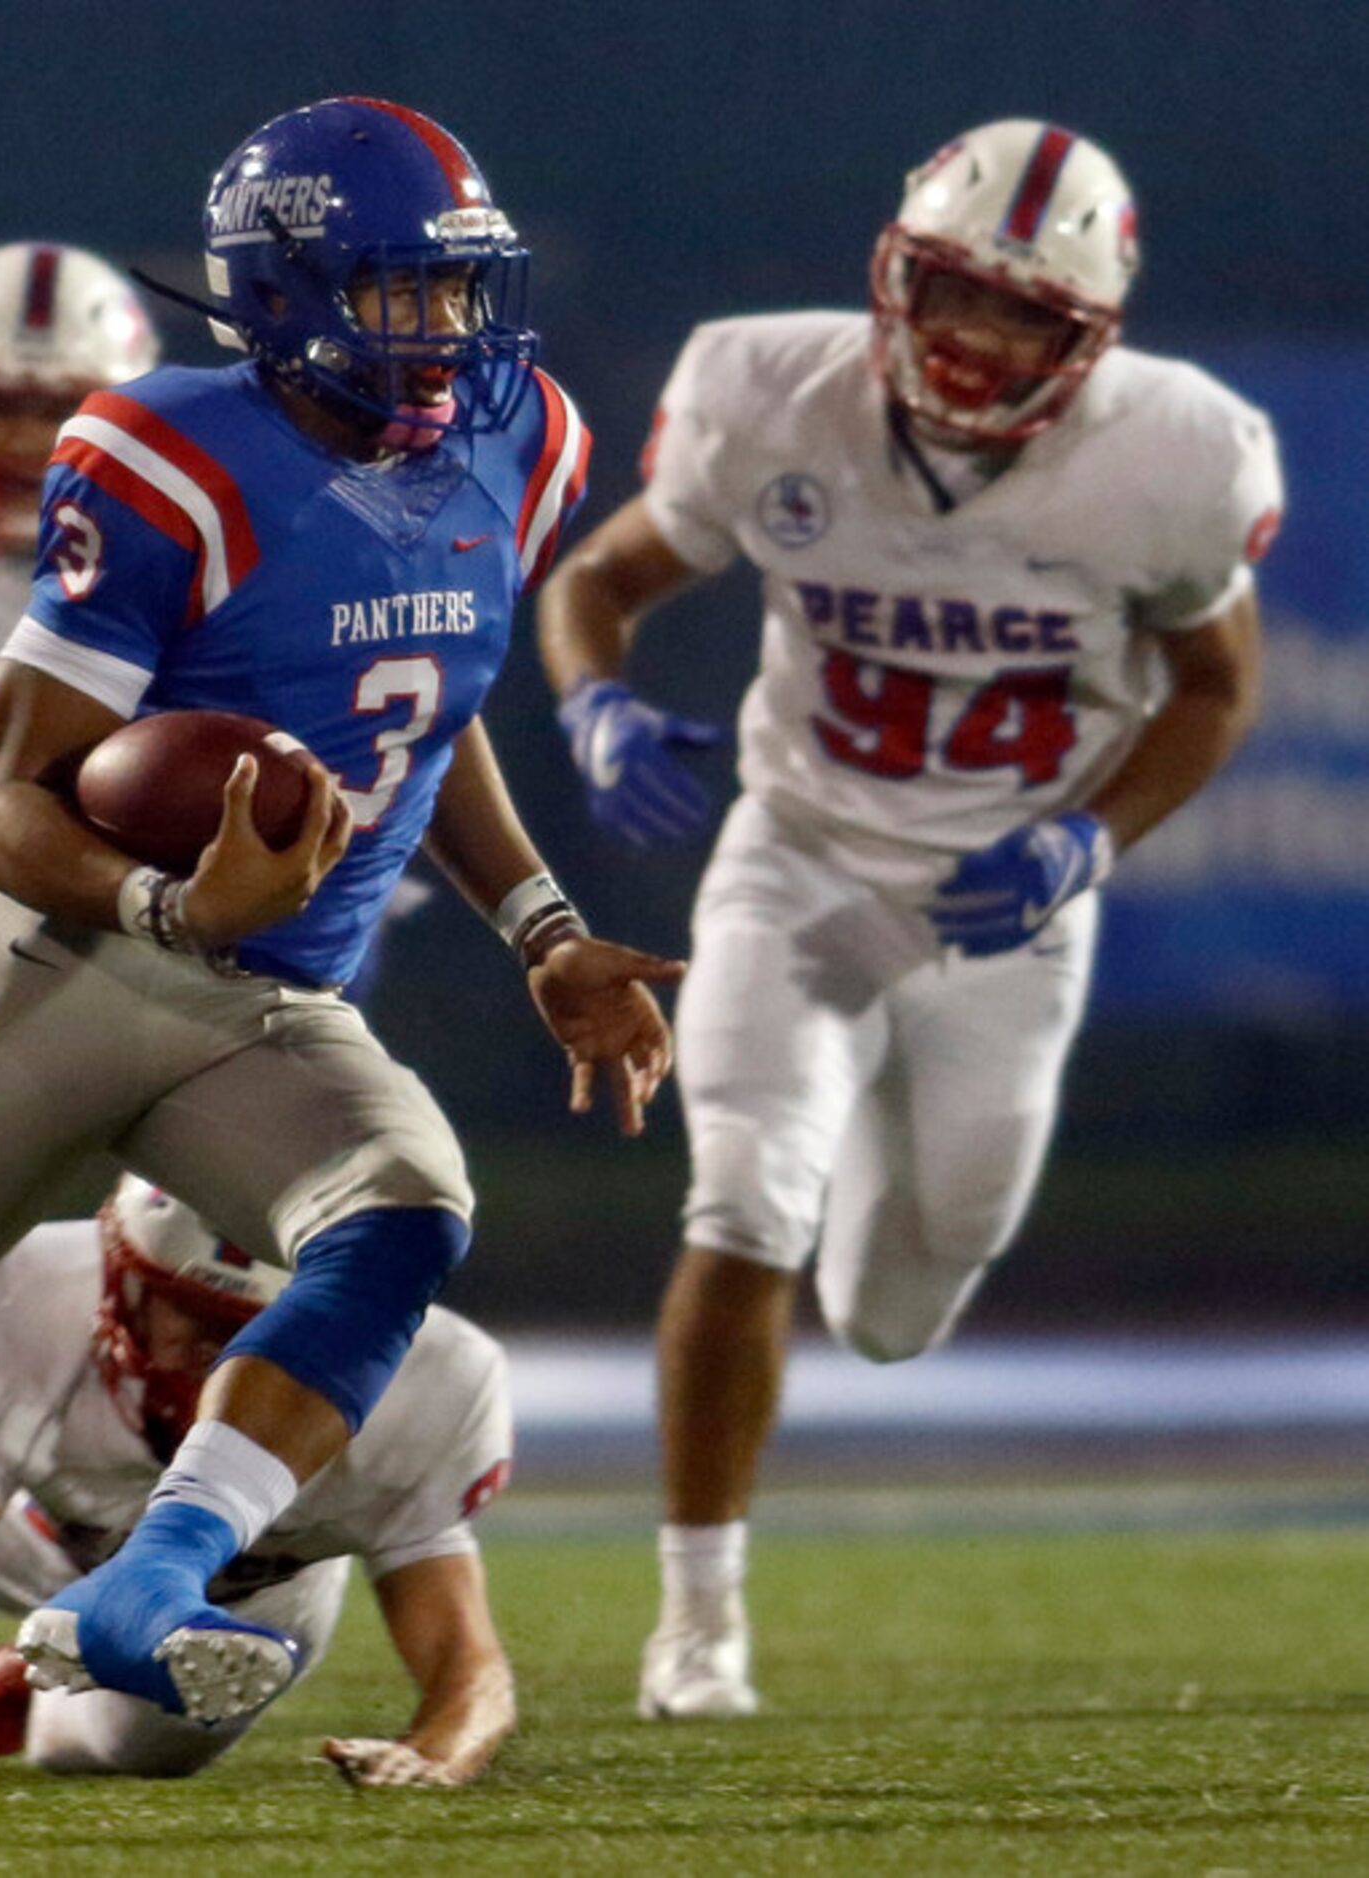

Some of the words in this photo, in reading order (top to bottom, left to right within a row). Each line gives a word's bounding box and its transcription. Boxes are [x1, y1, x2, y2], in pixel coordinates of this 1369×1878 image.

[53, 498, 101, 601] 3
[331, 591, 476, 646] PANTHERS
[795, 581, 1080, 652] PEARCE
[332, 654, 443, 831] 3
[811, 648, 1077, 790] 94
